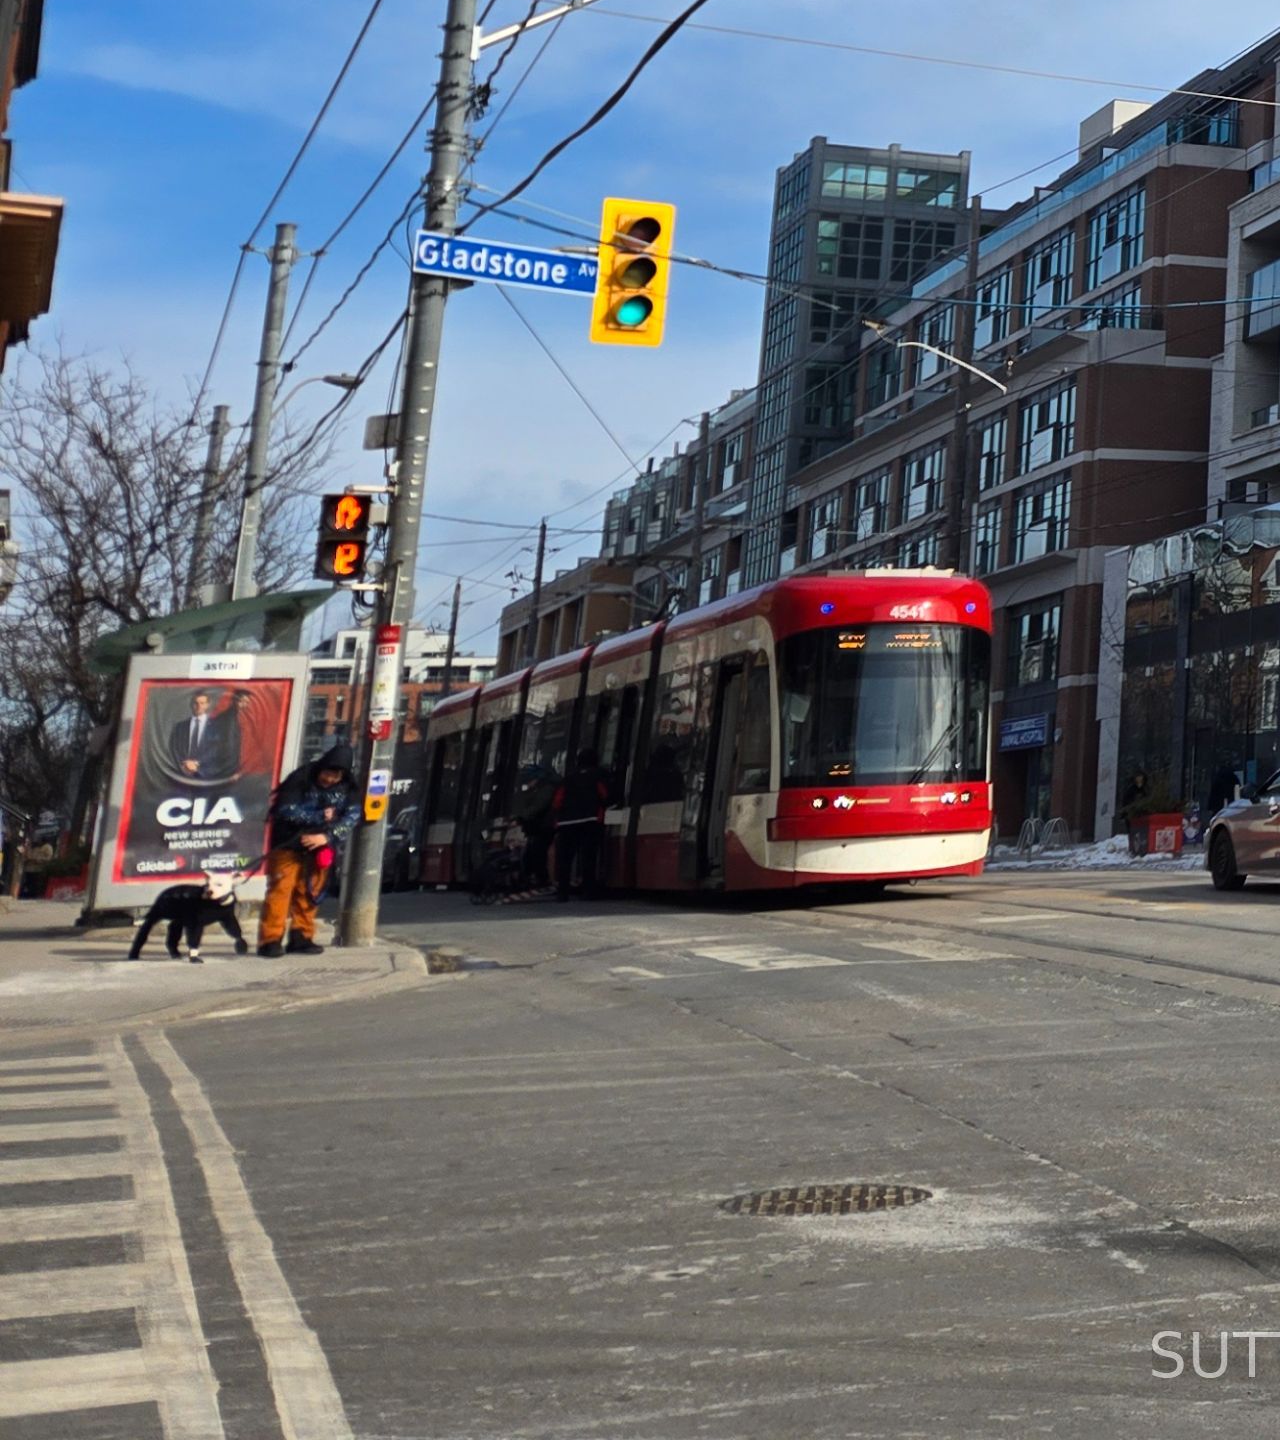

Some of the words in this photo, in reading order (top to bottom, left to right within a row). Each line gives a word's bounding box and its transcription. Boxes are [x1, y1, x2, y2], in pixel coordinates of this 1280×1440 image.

[418, 238, 568, 284] Gladstone
[889, 604, 926, 620] 4541
[203, 661, 238, 671] astral
[156, 796, 243, 827] CIA
[164, 831, 190, 841] NEW
[191, 829, 231, 840] SERIES
[168, 839, 224, 850] MONDAYS
[136, 860, 177, 872] Global
